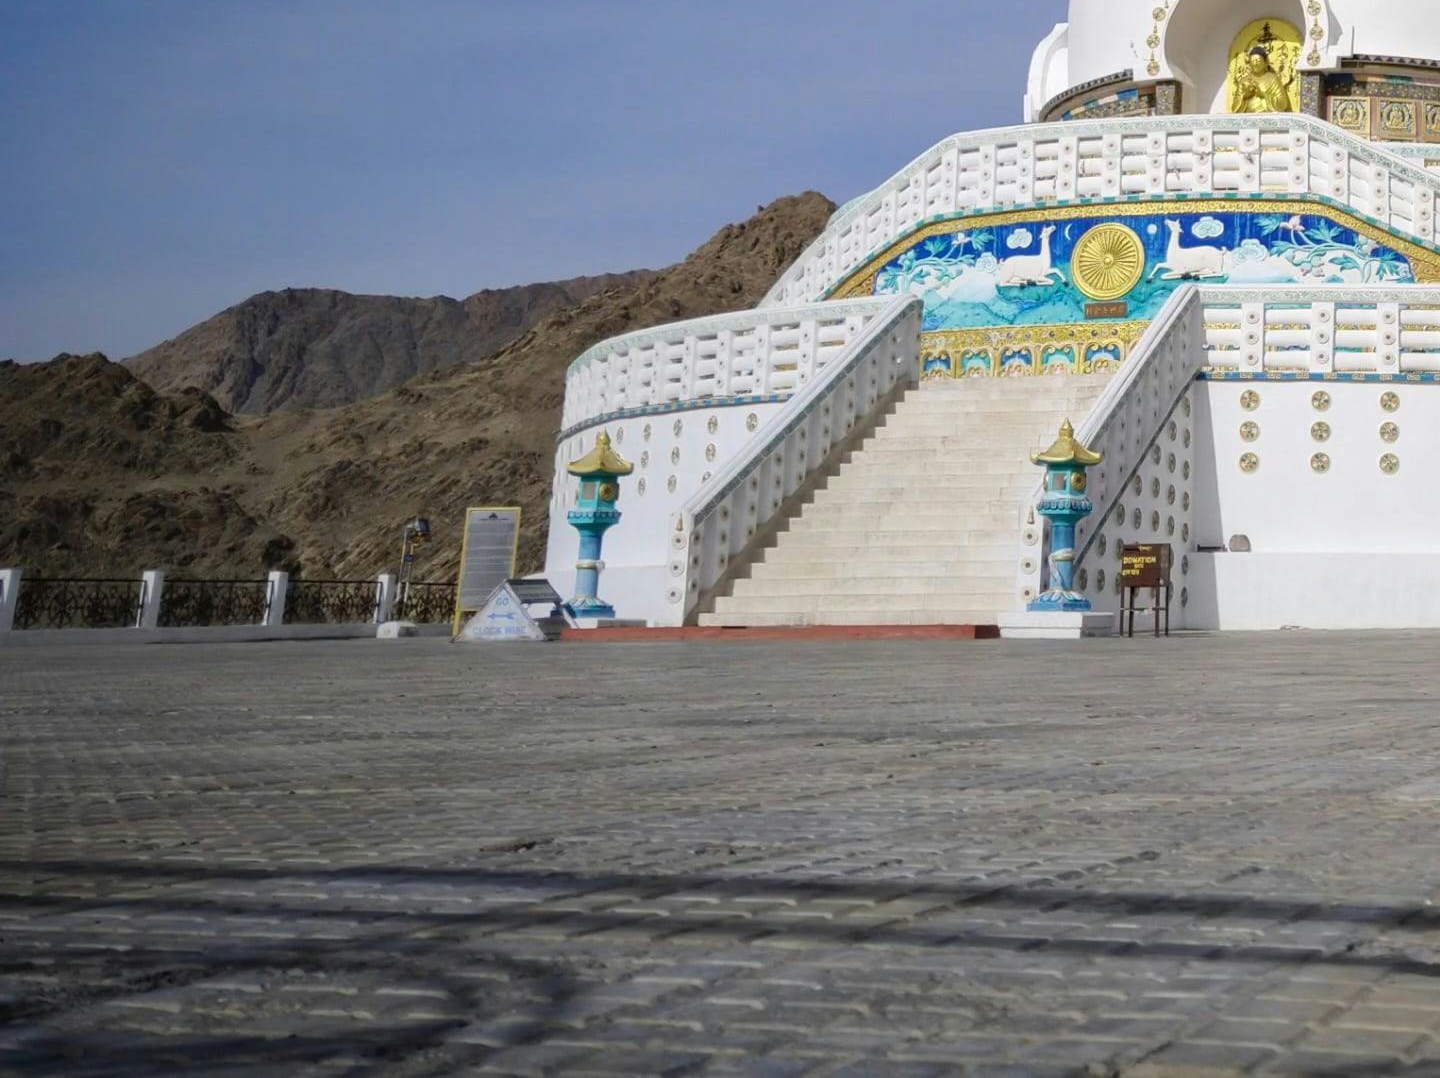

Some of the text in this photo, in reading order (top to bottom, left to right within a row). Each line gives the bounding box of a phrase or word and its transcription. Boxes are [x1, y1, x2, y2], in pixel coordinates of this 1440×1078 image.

[1122, 556, 1156, 564] DONATION
[495, 597, 509, 606] GO
[472, 626, 501, 635] CLOCK
